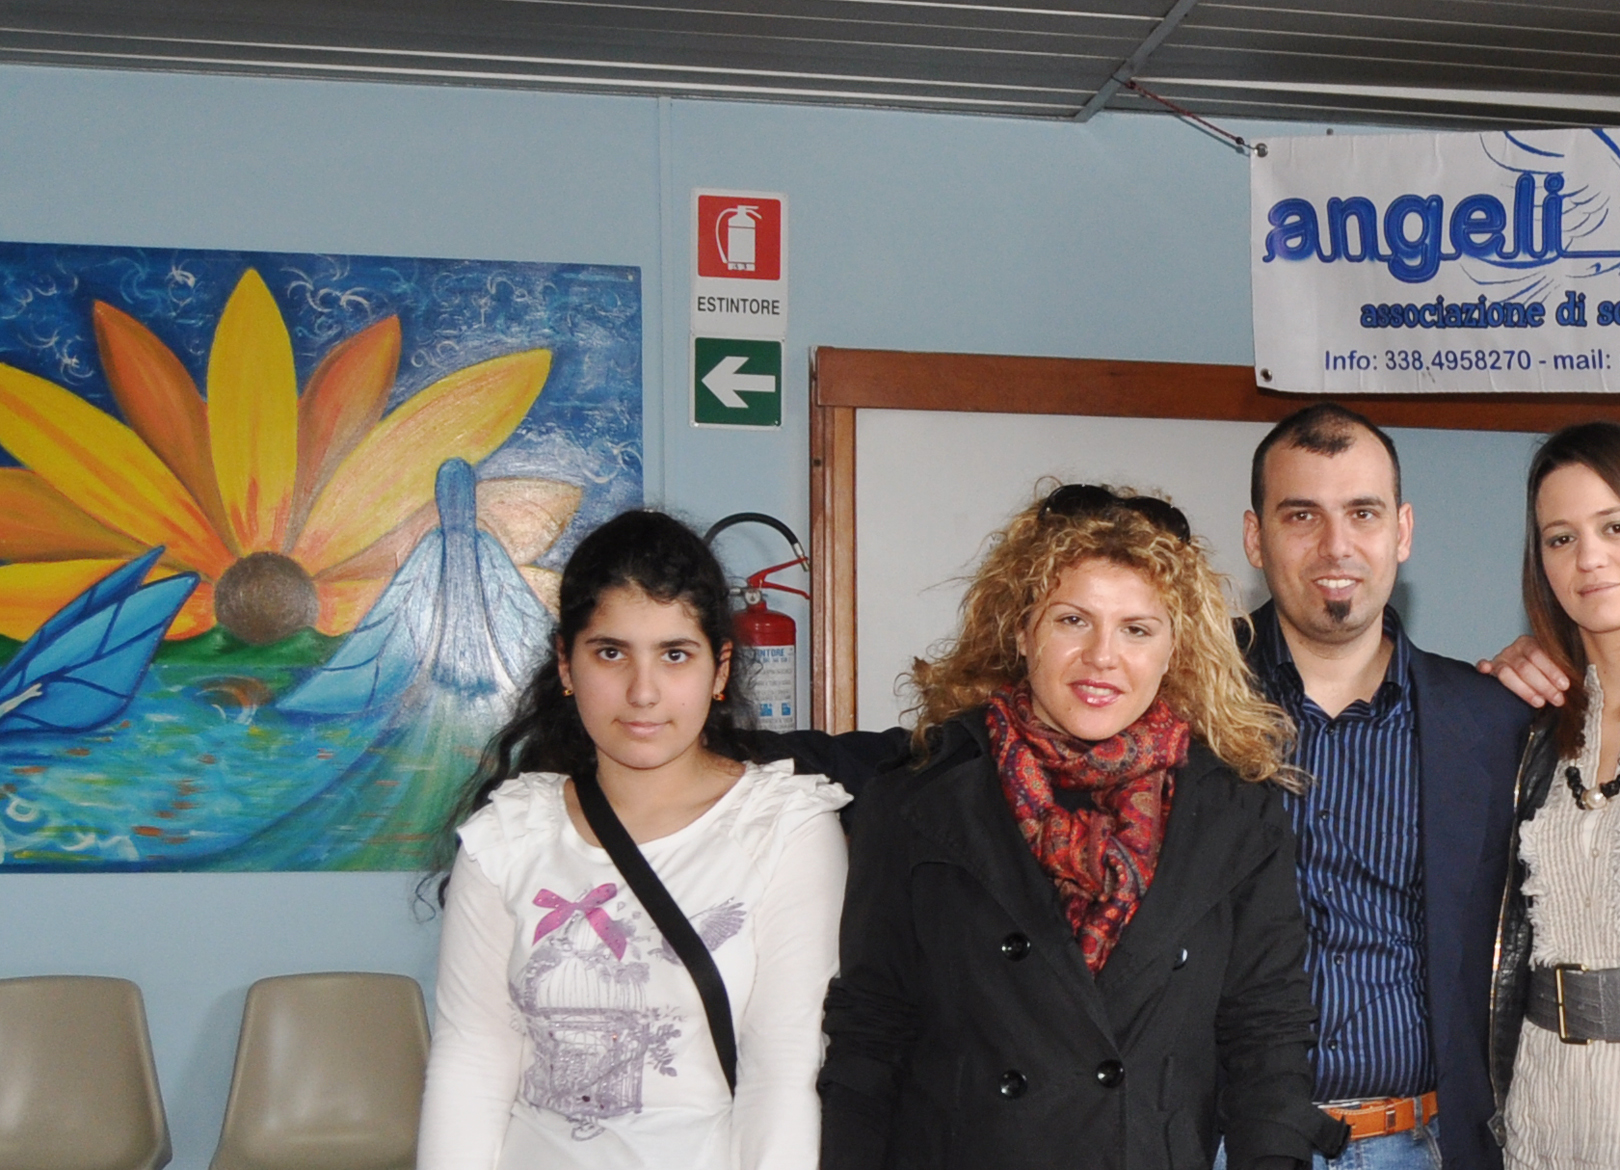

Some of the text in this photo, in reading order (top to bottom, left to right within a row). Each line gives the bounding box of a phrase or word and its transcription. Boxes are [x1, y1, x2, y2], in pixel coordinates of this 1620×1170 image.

[1263, 172, 1564, 283] angeli
[697, 296, 780, 315] ESTINTORE
[1360, 294, 1546, 328] associazione
[1556, 291, 1587, 327] di
[1325, 350, 1378, 371] Info:
[1385, 350, 1532, 371] 338.4958270
[1553, 348, 1611, 370] mail:
